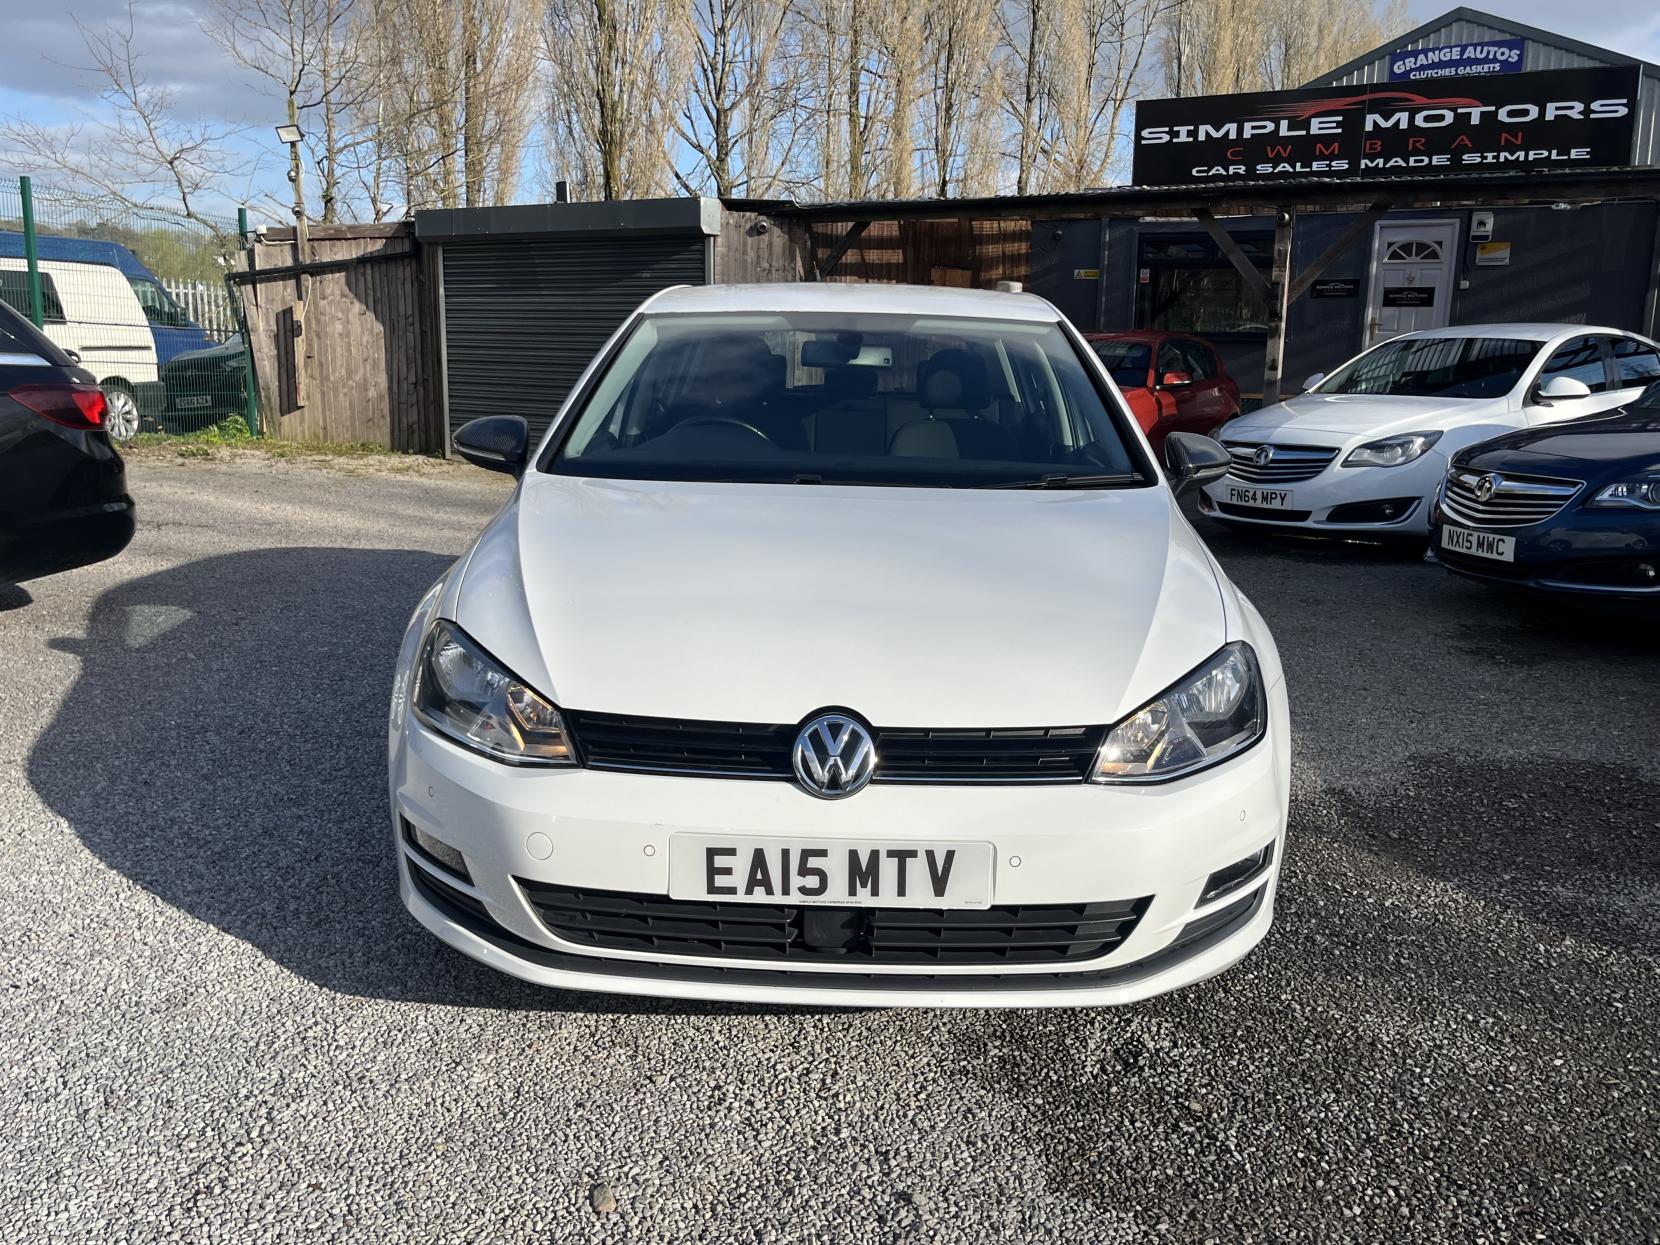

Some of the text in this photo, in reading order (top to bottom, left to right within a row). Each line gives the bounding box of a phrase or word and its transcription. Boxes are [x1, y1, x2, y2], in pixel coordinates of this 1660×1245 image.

[1393, 46, 1520, 74] GRANGE AUTOS
[1410, 63, 1501, 80] CLUTCHES GASKETS
[1141, 99, 1629, 145] SIMPLE MOTORS
[1191, 148, 1591, 177] CAR SALES MADE SIMPLE
[1229, 487, 1287, 506] FN64 MPY
[1447, 530, 1505, 556] NX15 MWC
[705, 847, 956, 898] EA15 MTV
